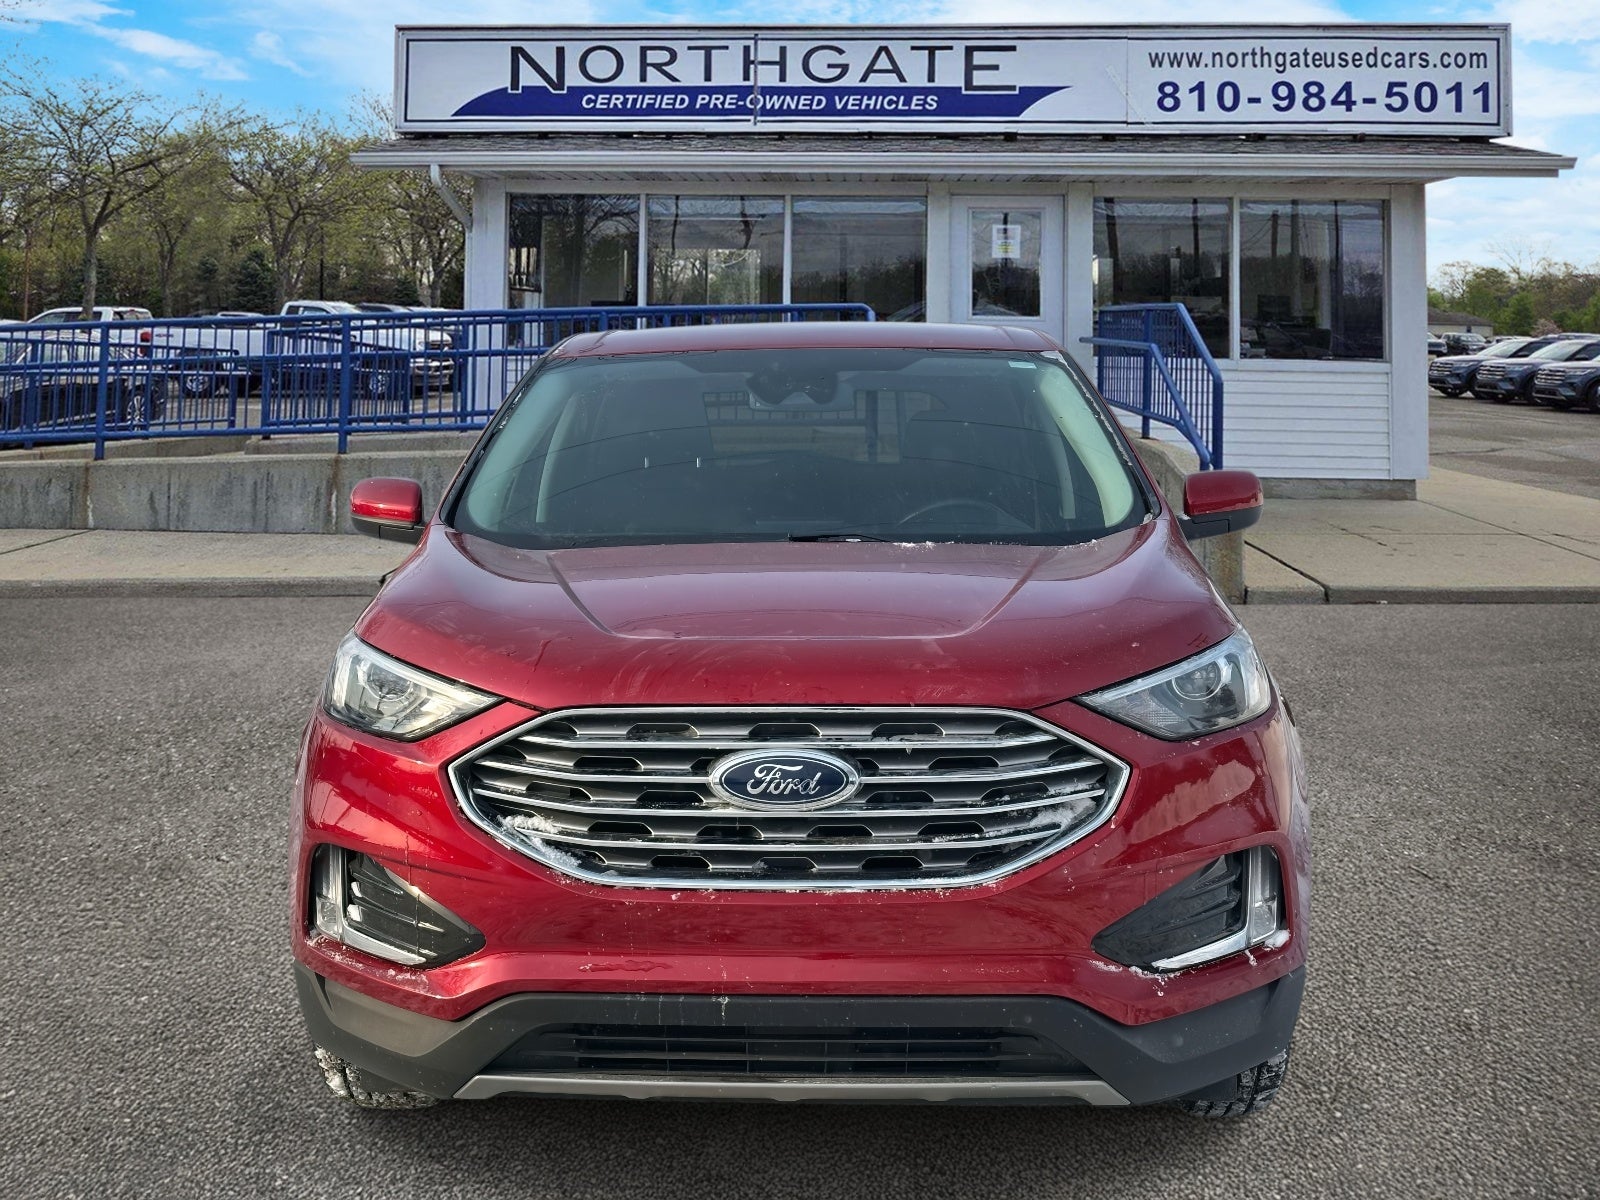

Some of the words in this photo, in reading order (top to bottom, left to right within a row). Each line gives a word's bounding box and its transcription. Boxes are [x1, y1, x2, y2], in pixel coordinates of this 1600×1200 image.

[510, 45, 1017, 93] NORTHGATE
[1148, 46, 1488, 73] www.northgateusedcars.com
[580, 93, 691, 111] CERTIFIED
[695, 93, 828, 111] PRE-OWNED
[833, 94, 940, 112] VEHICLES
[1156, 81, 1490, 113] 810-984-5011
[747, 764, 822, 795] Ford
